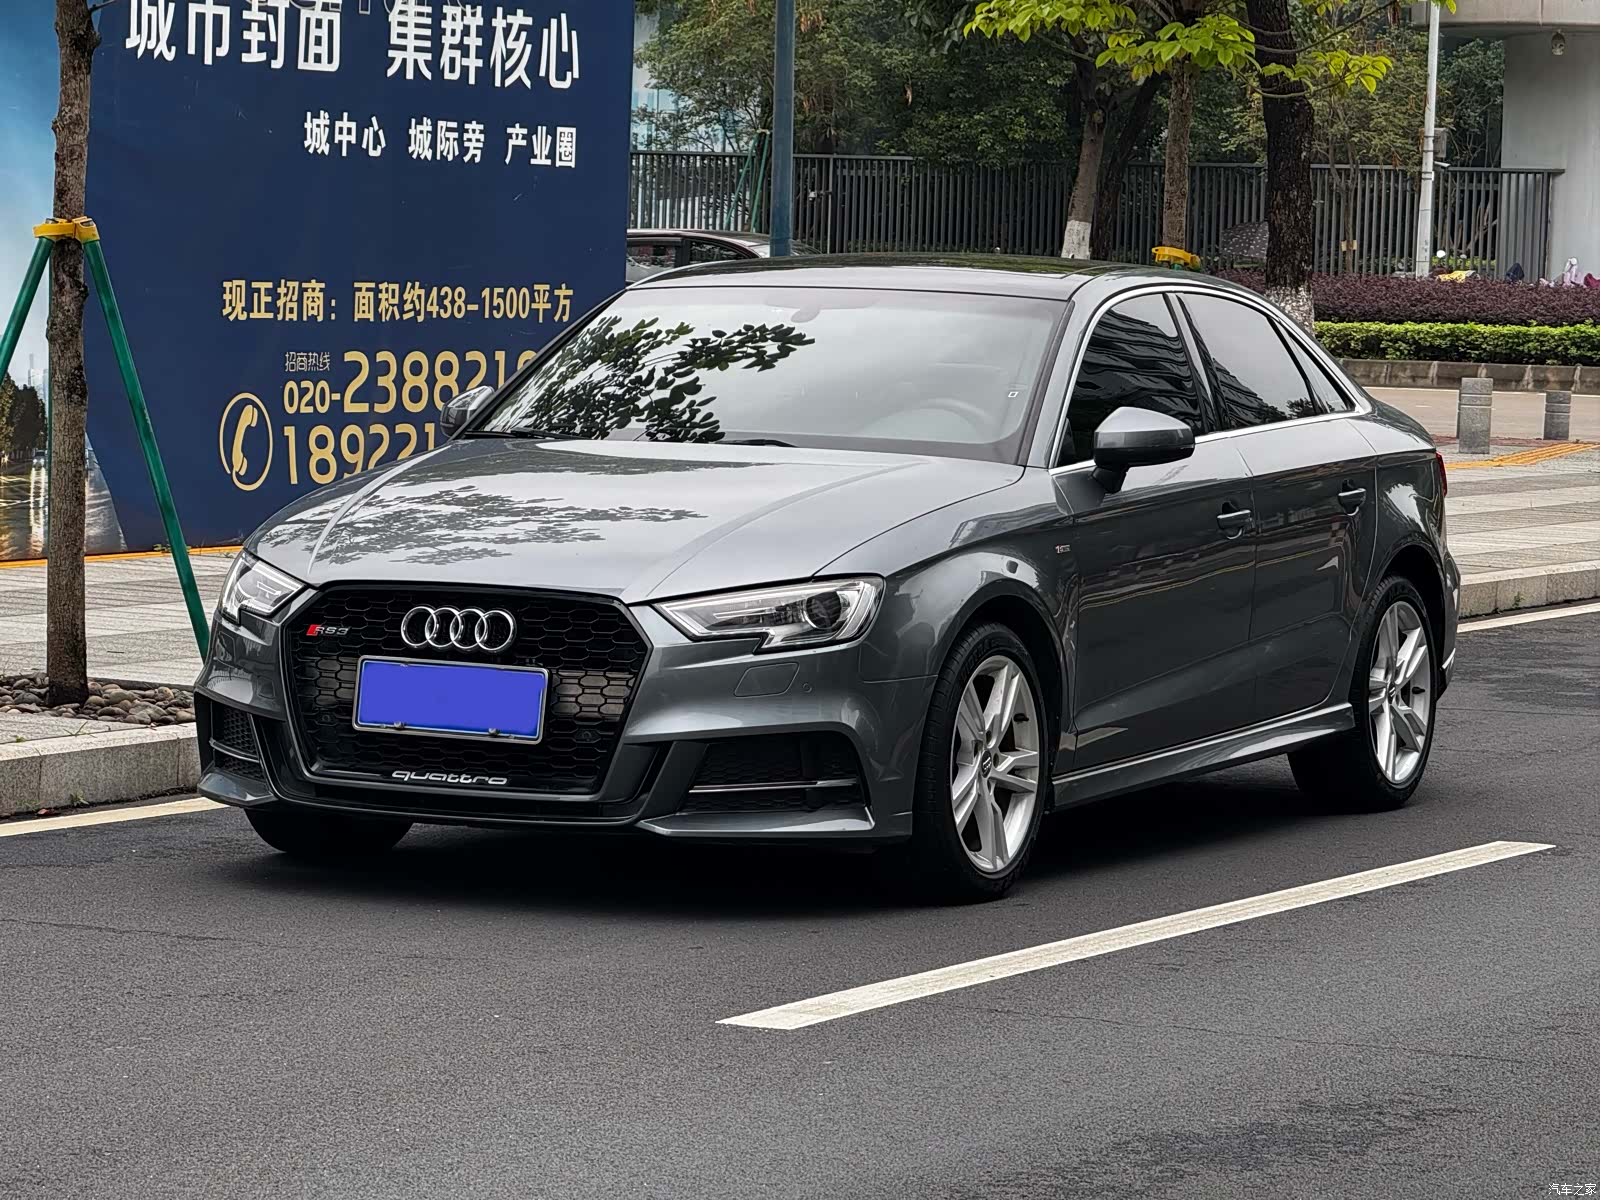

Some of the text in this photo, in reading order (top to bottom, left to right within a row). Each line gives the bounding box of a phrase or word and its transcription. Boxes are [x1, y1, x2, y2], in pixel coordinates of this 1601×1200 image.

[386, 0, 580, 89] 集群核心
[304, 110, 577, 168] 城中心 城际旁 产业圈
[285, 352, 331, 372] 招商热线
[311, 625, 349, 636] RS3
[391, 770, 508, 785] quattro
